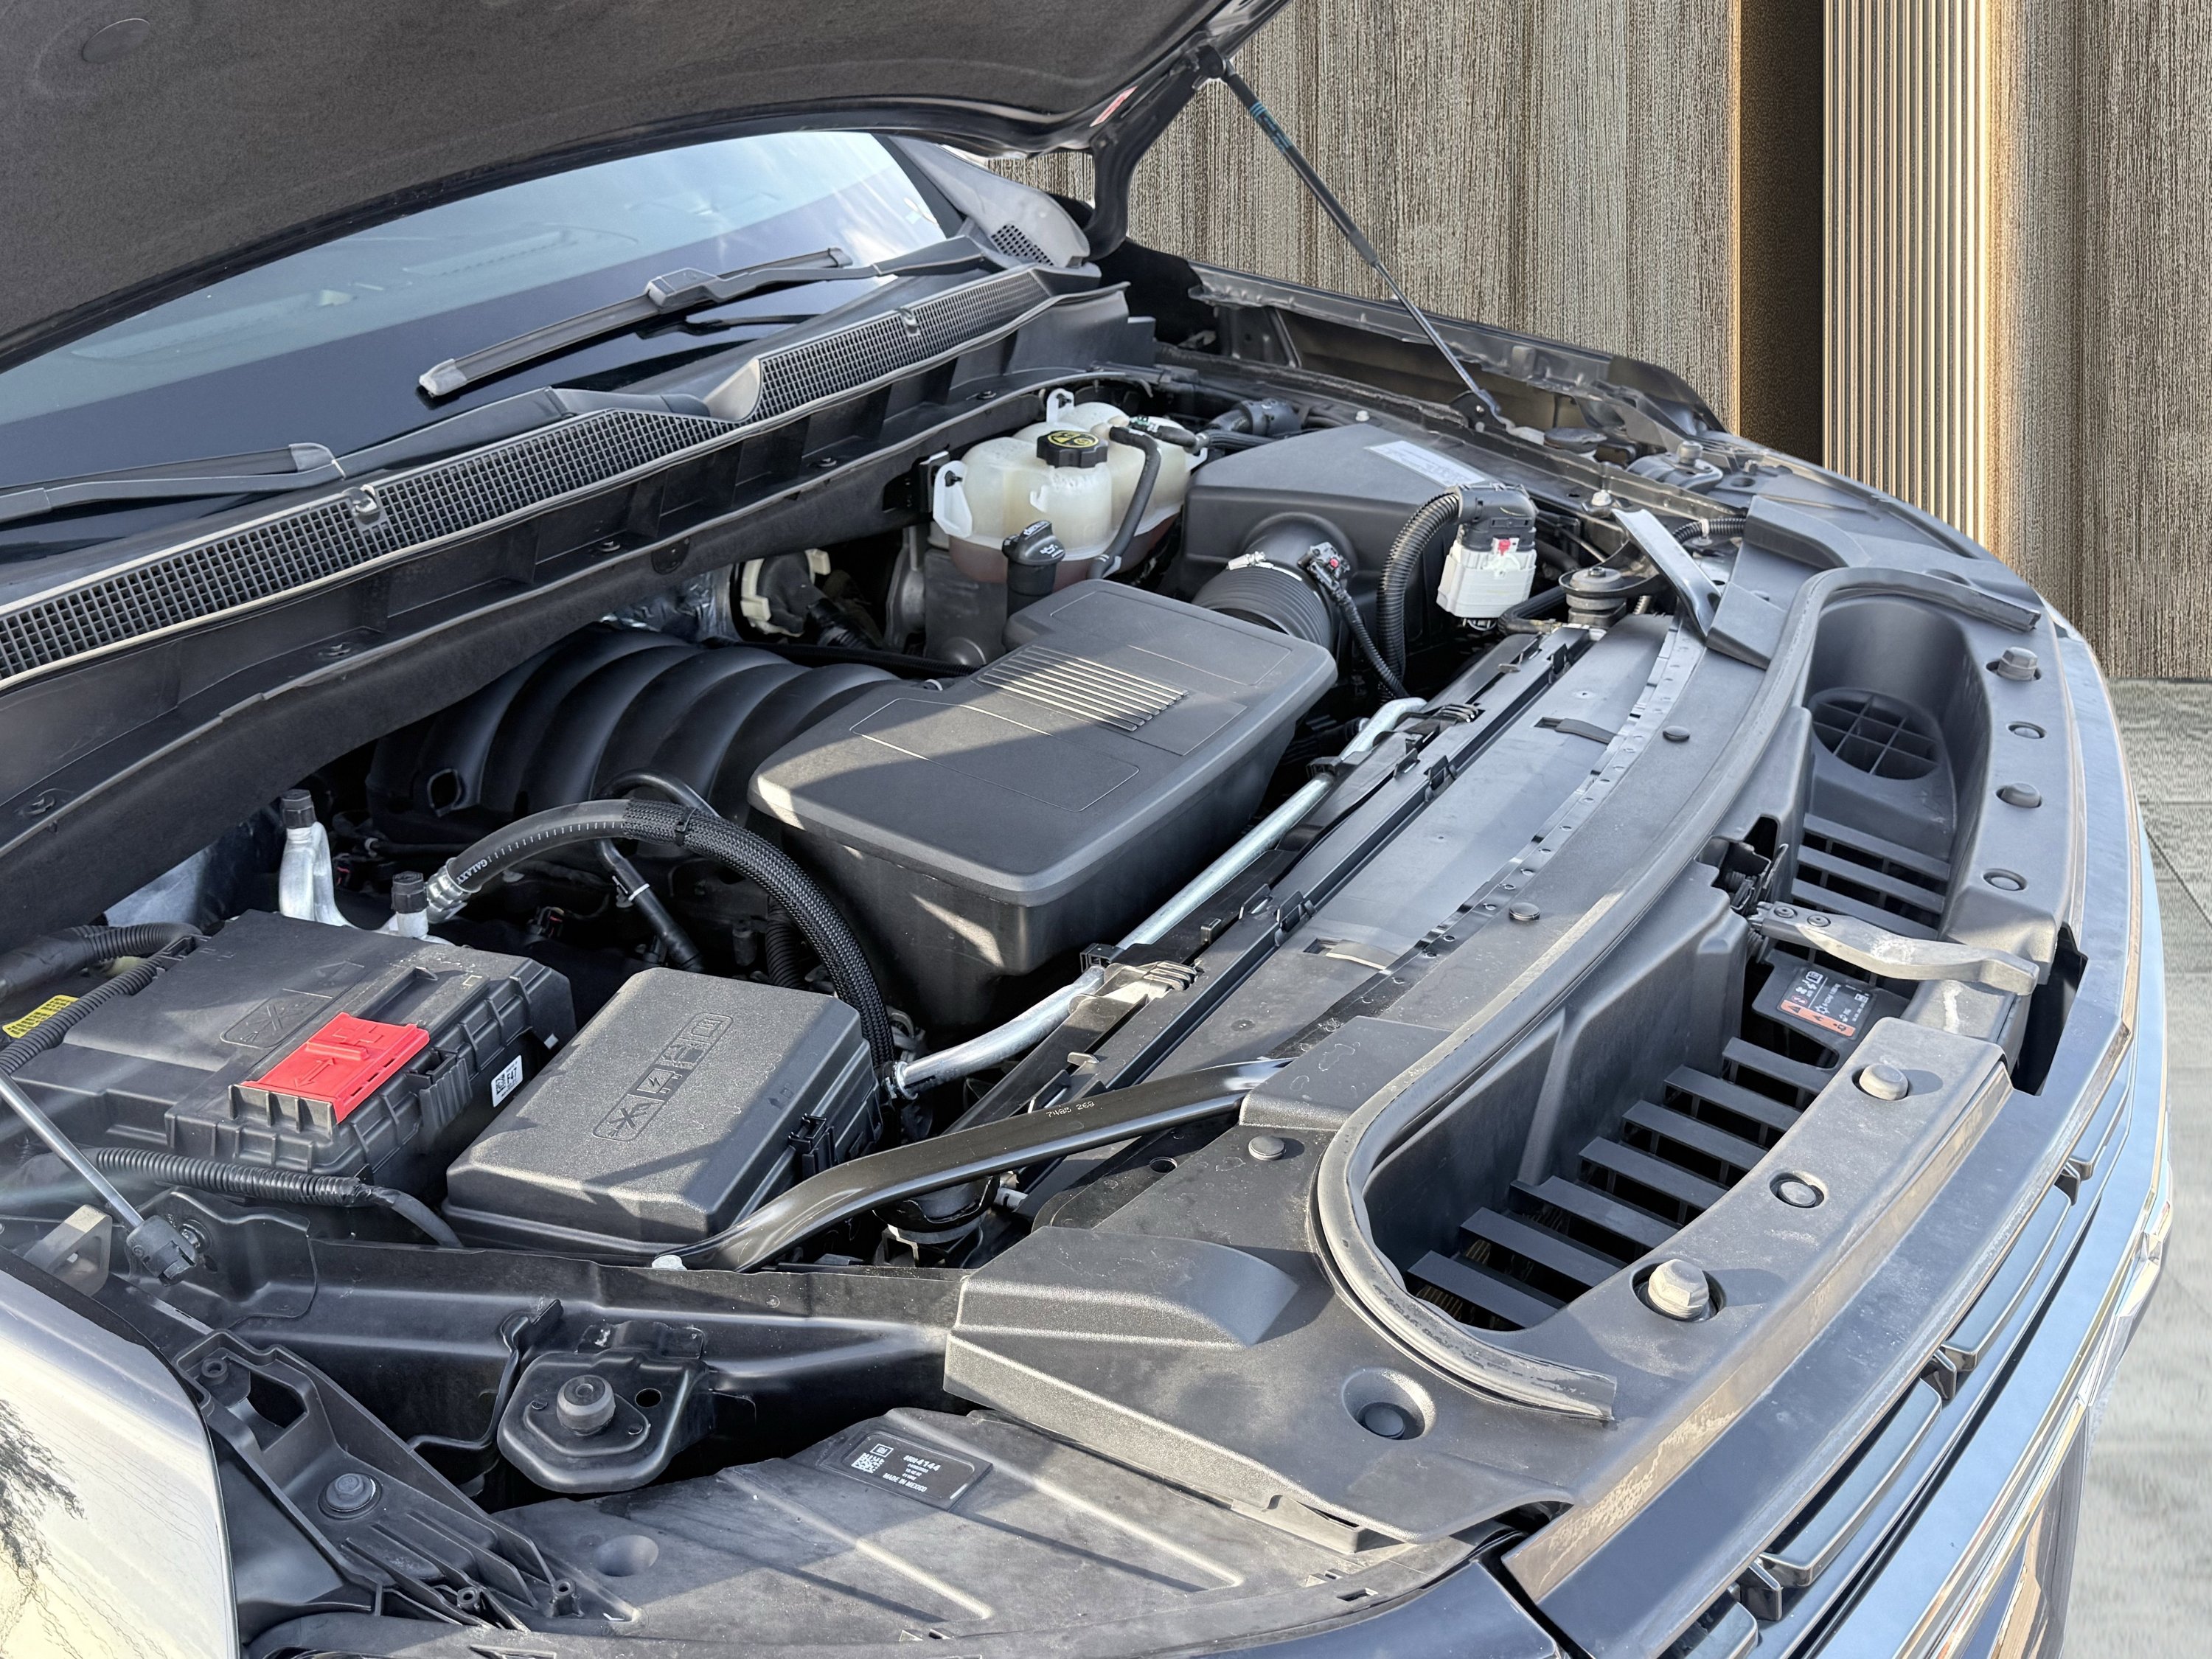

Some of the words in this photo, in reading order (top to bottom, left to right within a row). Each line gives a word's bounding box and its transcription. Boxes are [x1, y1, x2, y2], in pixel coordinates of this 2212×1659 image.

[456, 859, 488, 885] GALAXY
[507, 1067, 517, 1084] F47
[882, 1472, 900, 1483] MADE
[905, 1480, 928, 1492] MEXICO
